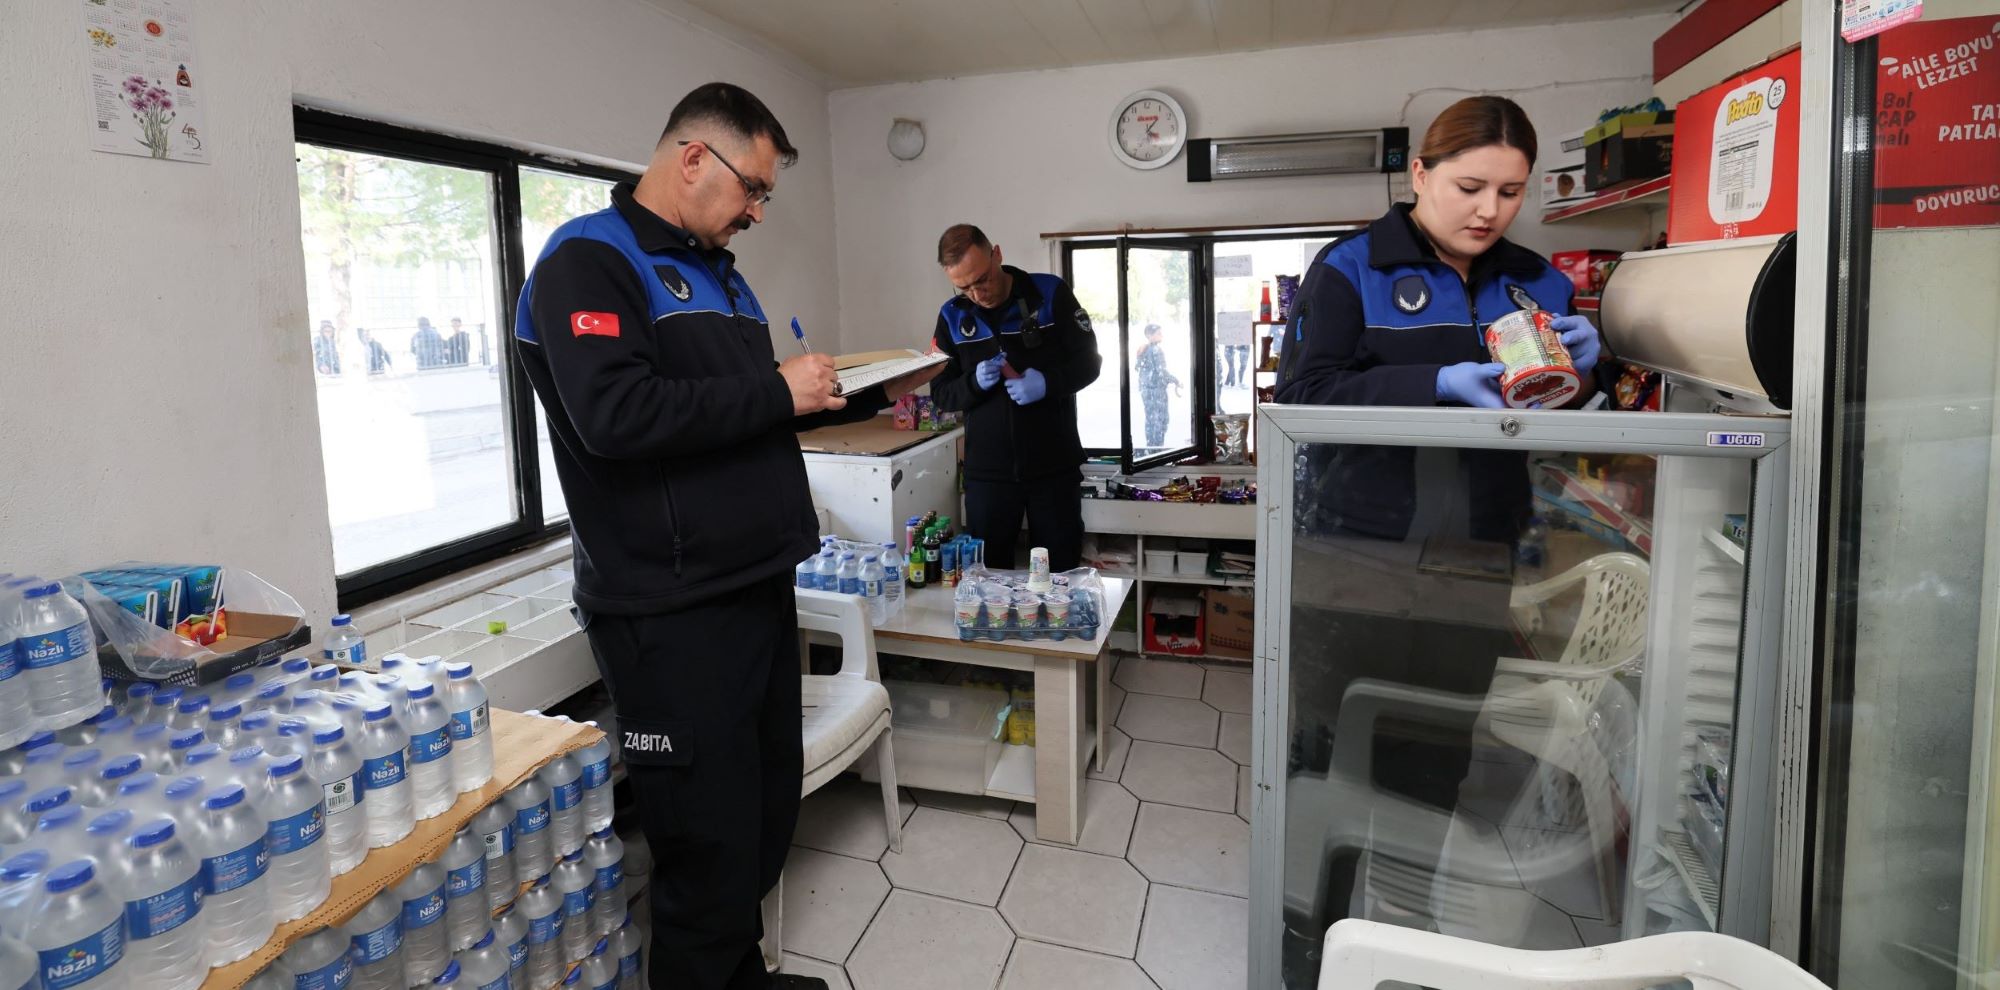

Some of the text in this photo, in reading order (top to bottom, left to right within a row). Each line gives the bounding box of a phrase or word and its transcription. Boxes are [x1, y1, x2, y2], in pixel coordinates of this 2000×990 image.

[1902, 35, 1993, 79] AİLE BOYU
[1917, 57, 1978, 90] LEZZET
[1938, 123, 2000, 142] PATLA
[1726, 433, 1761, 445] UĞUR
[28, 645, 64, 659] Nazlı
[624, 732, 673, 752] ZABITA
[372, 764, 400, 780] Nazlı
[48, 954, 97, 979] Nazlı
